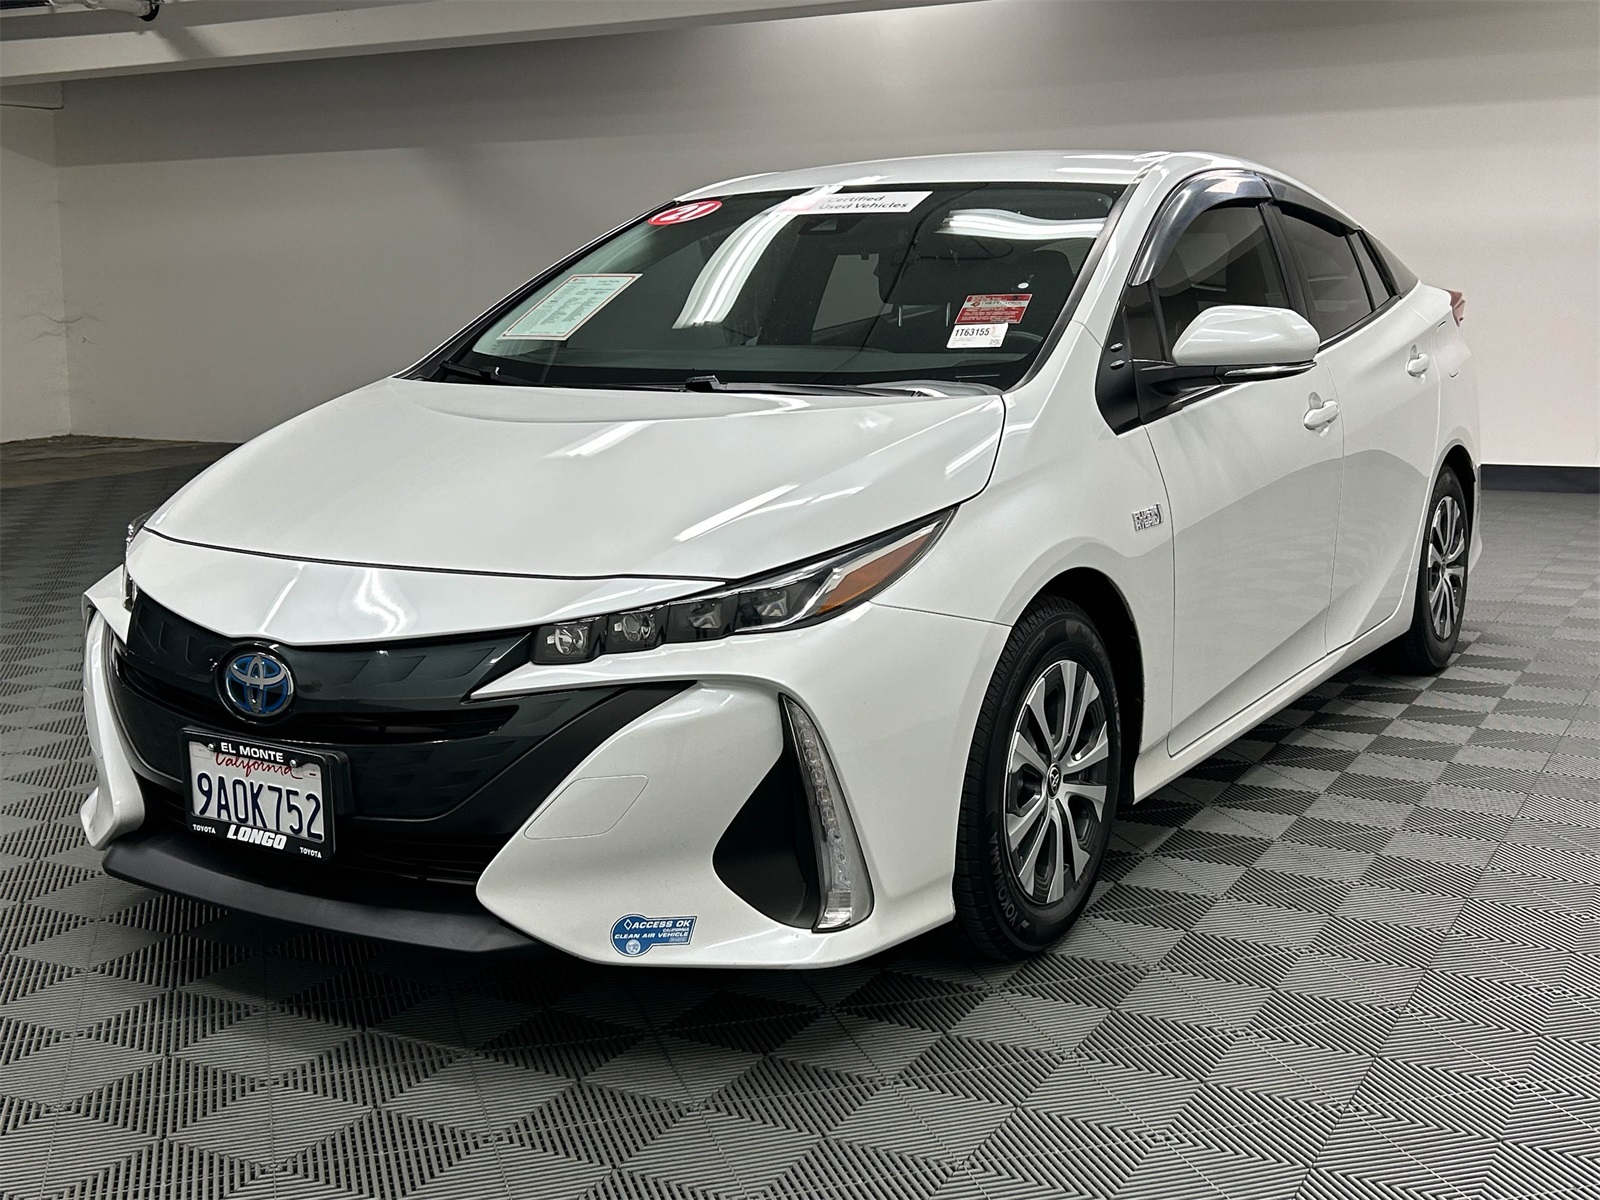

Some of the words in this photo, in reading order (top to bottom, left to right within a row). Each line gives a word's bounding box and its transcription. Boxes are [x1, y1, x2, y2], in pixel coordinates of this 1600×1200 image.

[818, 202, 852, 210] Used
[854, 201, 907, 209] Vehicles
[827, 195, 886, 203] Certified
[659, 203, 716, 221] 21
[955, 328, 990, 337] 1T63155
[220, 742, 236, 754] EL
[239, 746, 284, 763] MONTE
[215, 752, 303, 779] California
[192, 824, 216, 834] TOYOTA
[226, 824, 287, 850] LONGO
[299, 846, 322, 859] TOYOTA
[989, 831, 1018, 926] YOKOHAMA
[631, 921, 673, 929] ACCESS
